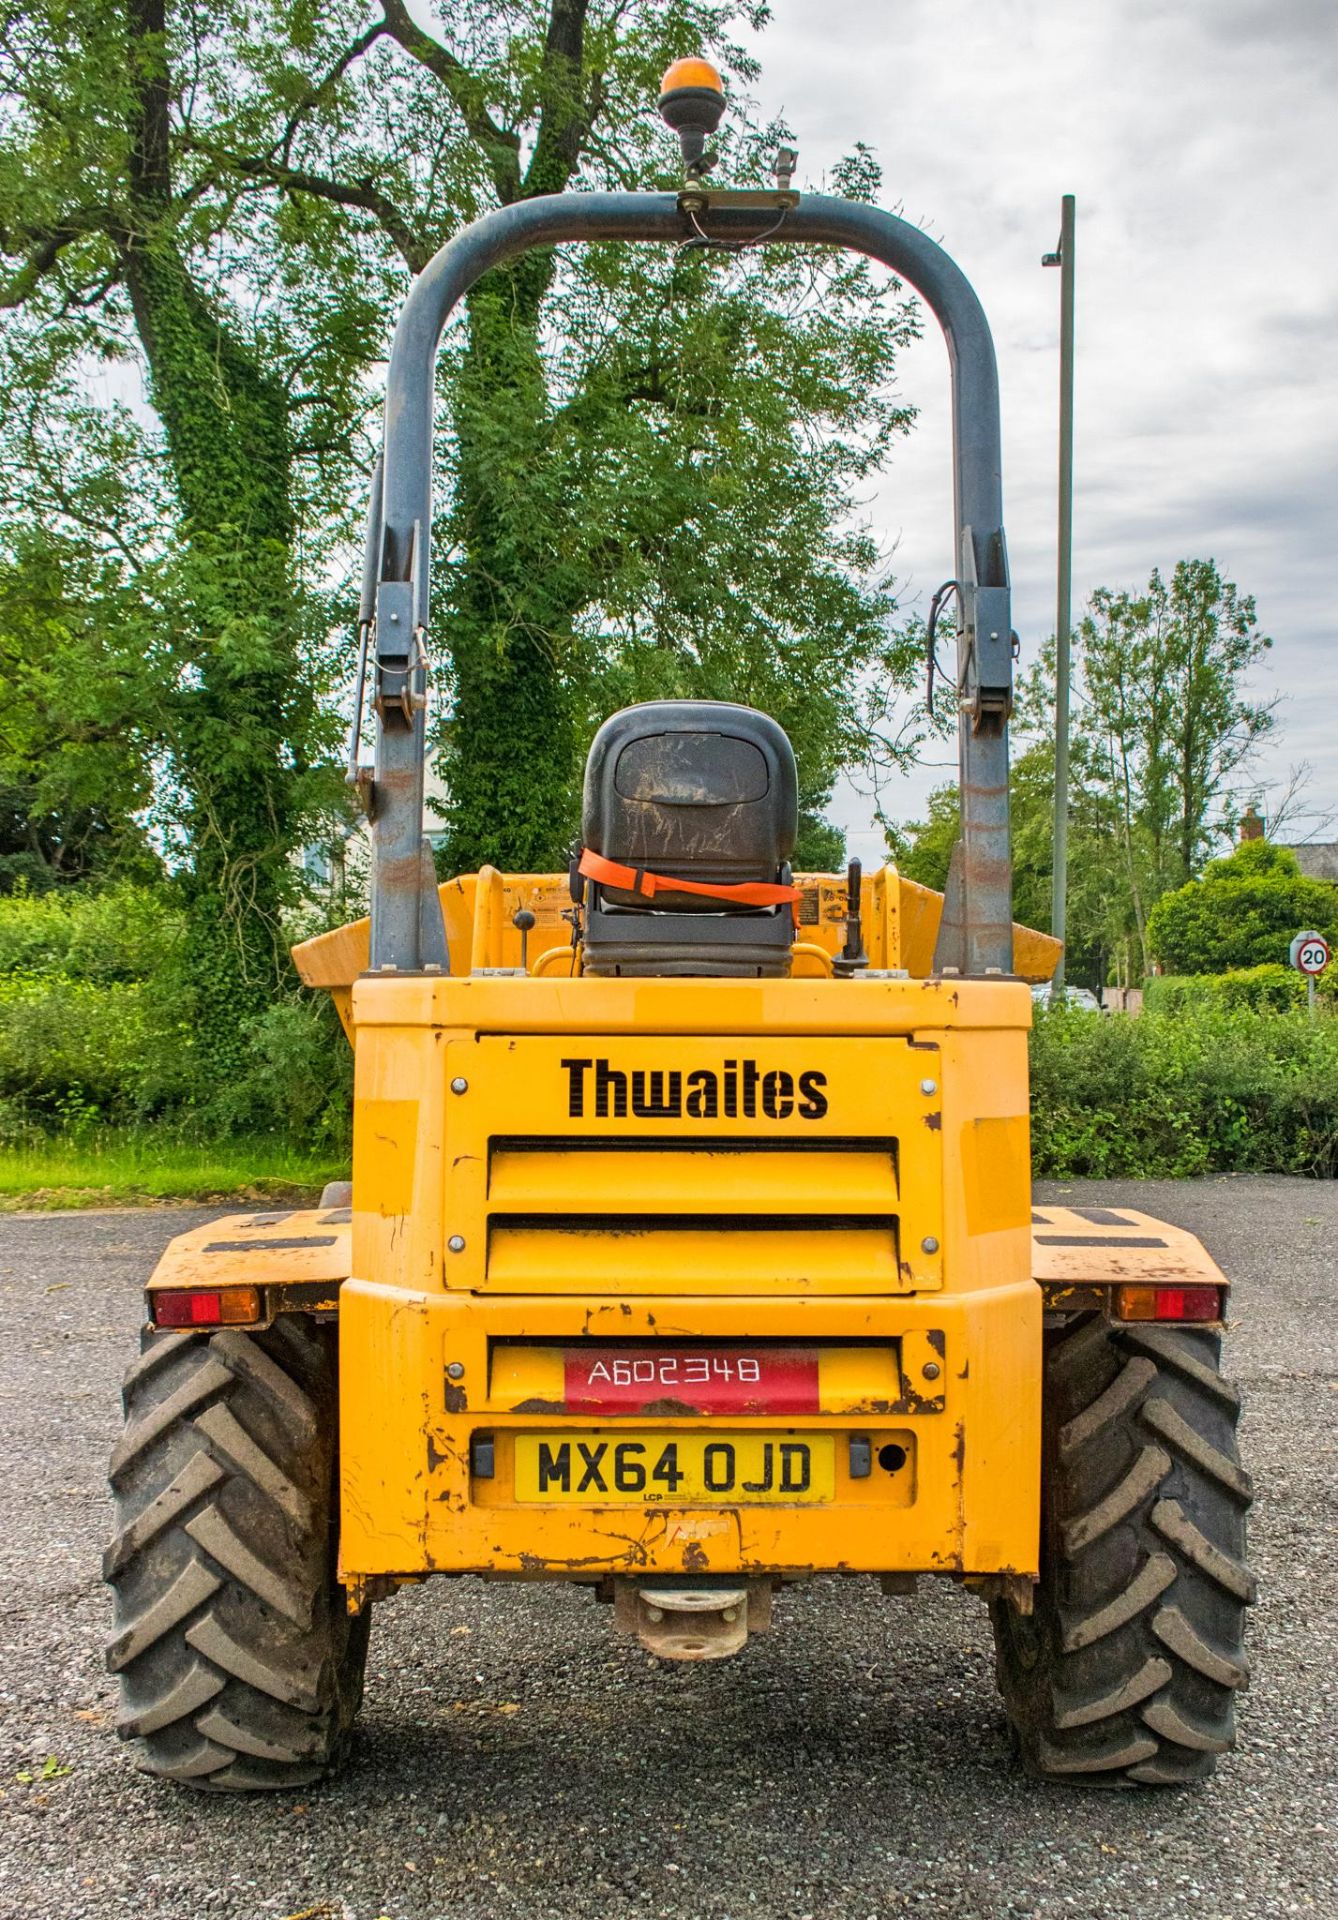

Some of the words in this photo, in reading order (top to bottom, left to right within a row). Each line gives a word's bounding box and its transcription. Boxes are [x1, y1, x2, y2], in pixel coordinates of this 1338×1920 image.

[1303, 950, 1324, 964] 20
[560, 1058, 828, 1120] Thwaites
[588, 1358, 761, 1386] A602348
[538, 1442, 684, 1493] MX64
[703, 1442, 812, 1493] OJD
